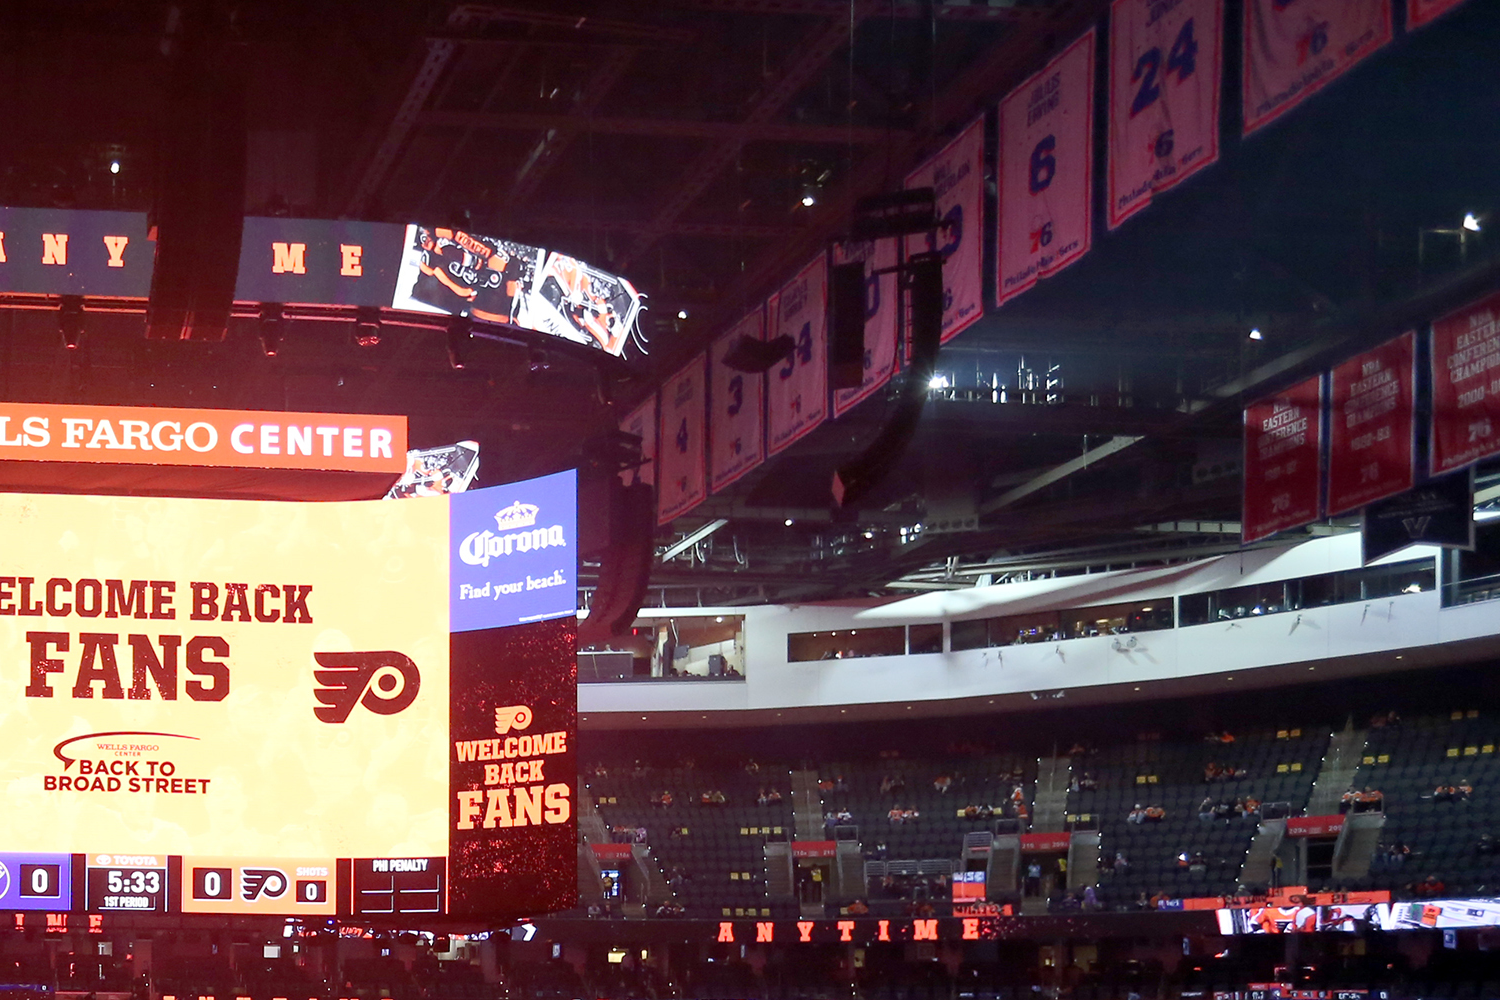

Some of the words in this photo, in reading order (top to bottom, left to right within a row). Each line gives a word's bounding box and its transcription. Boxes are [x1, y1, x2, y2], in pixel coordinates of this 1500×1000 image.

[1130, 16, 1198, 120] 24
[1029, 134, 1056, 197] 6
[1029, 221, 1054, 255] 76
[1350, 367, 1393, 398] EASTERN
[1262, 407, 1300, 433] EASTERN
[62, 417, 218, 452] FARGO
[230, 424, 393, 459] CENTER
[459, 524, 567, 567] Corona
[460, 583, 490, 600] Find
[494, 577, 523, 601] your
[190, 581, 313, 624] BACK
[25, 631, 230, 702] FANS
[97, 743, 128, 751] WELLS
[456, 731, 567, 762] WELCOME
[79, 760, 138, 776] BACK
[147, 761, 175, 777] TO
[484, 759, 544, 786] BACK
[44, 775, 121, 792] BROAD
[129, 778, 210, 794] STREET
[457, 783, 570, 830] FANS
[113, 855, 157, 867] TOYOTA
[296, 867, 328, 877] SHOTS
[372, 859, 387, 872] PHI
[389, 859, 428, 873] PENALTY
[31, 868, 49, 894] 0
[107, 871, 160, 894] 5:33
[204, 872, 220, 897] 0
[305, 884, 317, 900] 0
[104, 896, 118, 908] 1ST
[120, 896, 149, 908] PERIOD
[718, 919, 980, 942] ANYTIME
